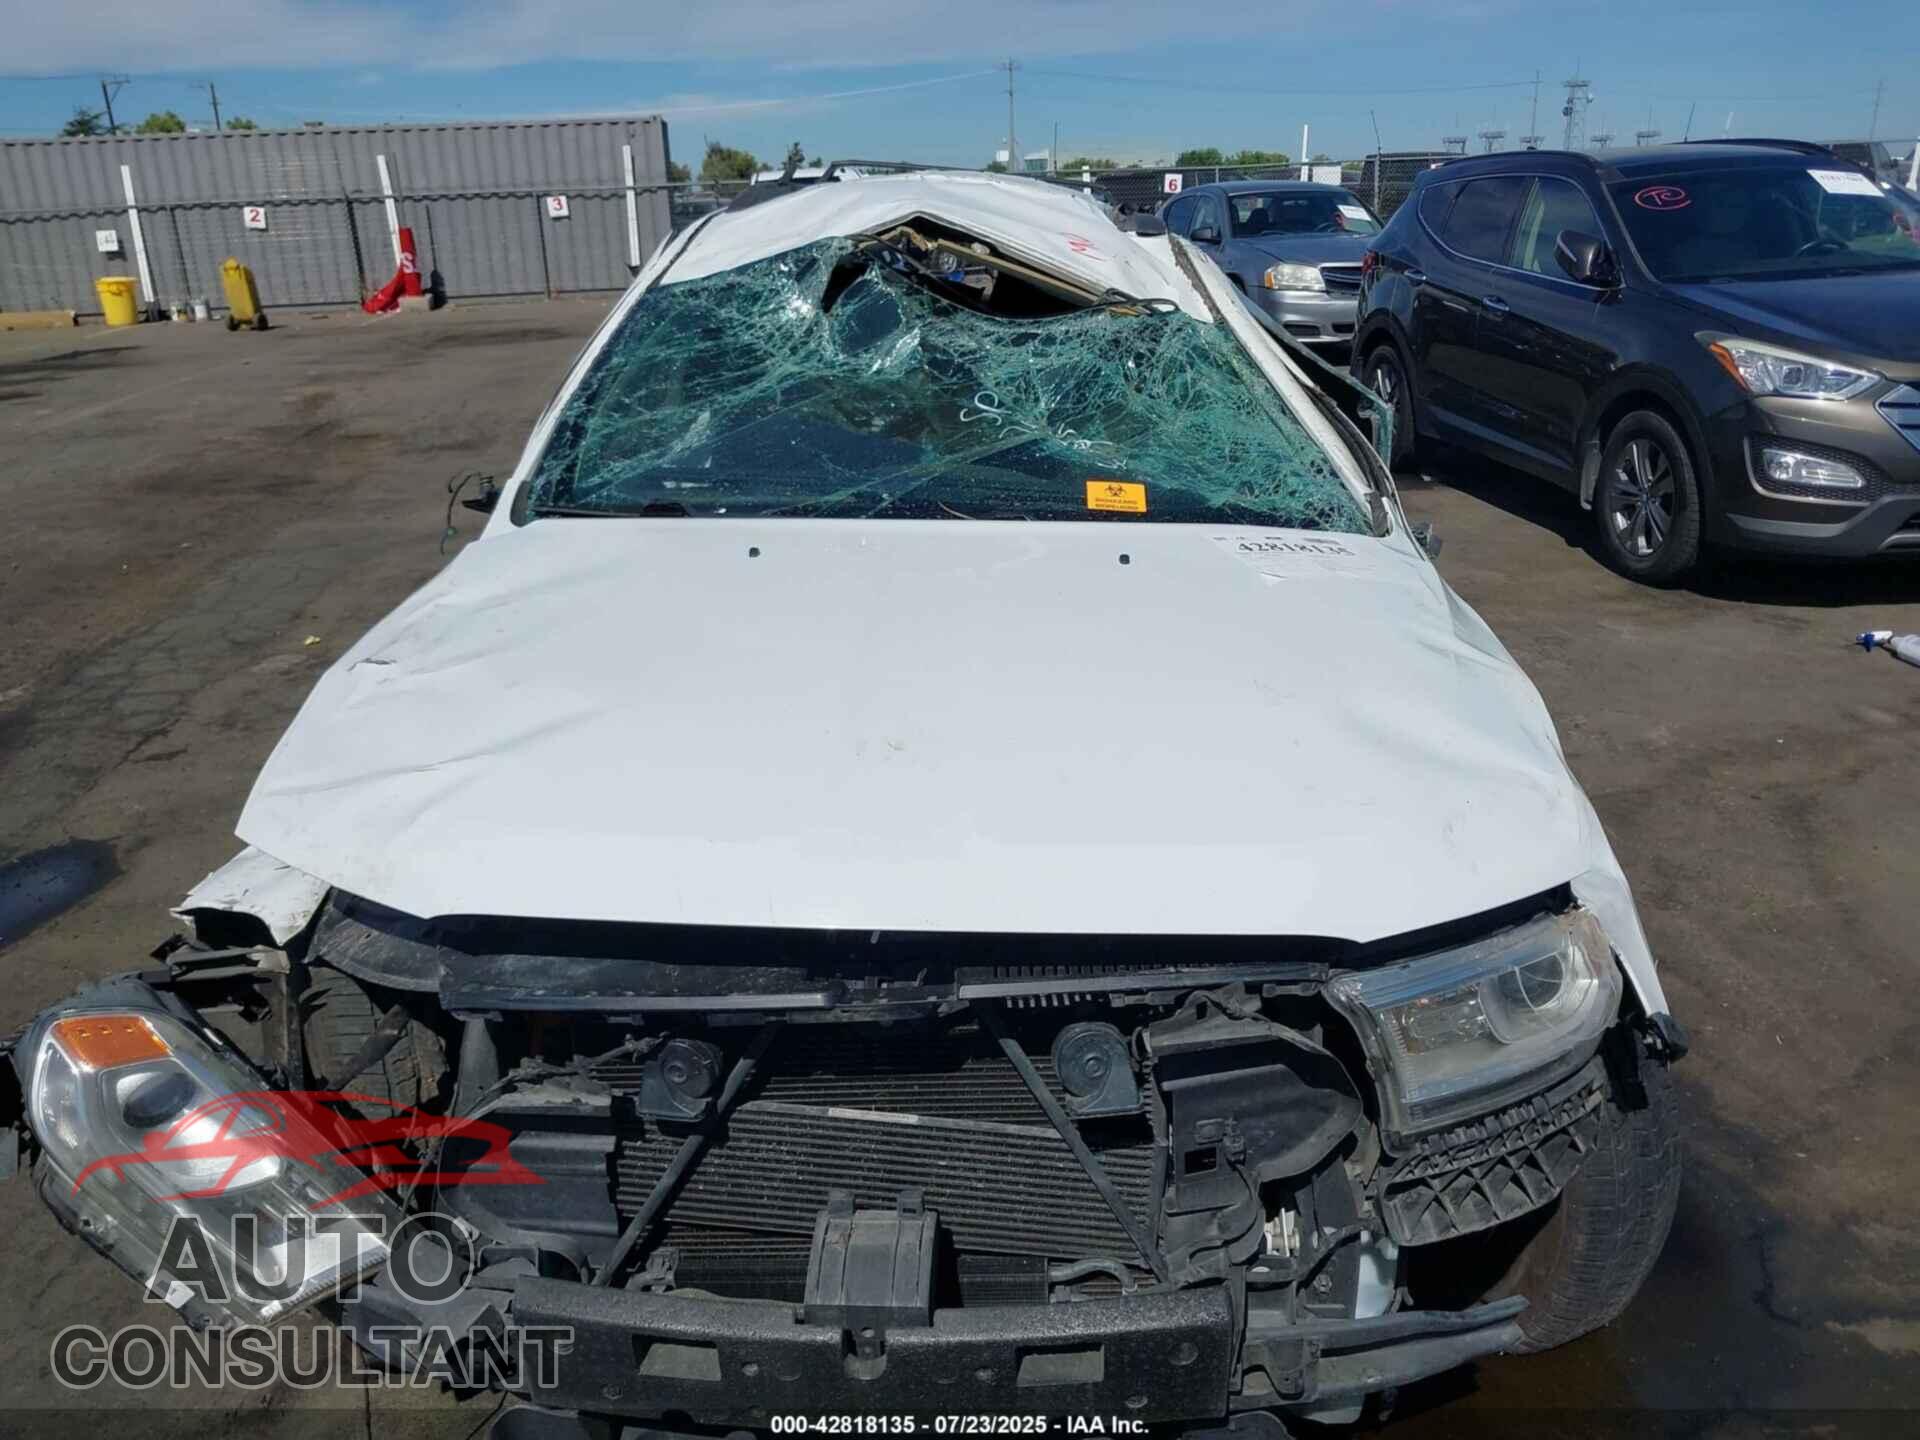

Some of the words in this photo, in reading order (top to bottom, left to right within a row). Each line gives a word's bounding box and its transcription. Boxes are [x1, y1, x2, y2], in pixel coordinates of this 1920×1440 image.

[1168, 178, 1178, 191] 6
[552, 198, 563, 211] 3
[249, 208, 261, 222] 2
